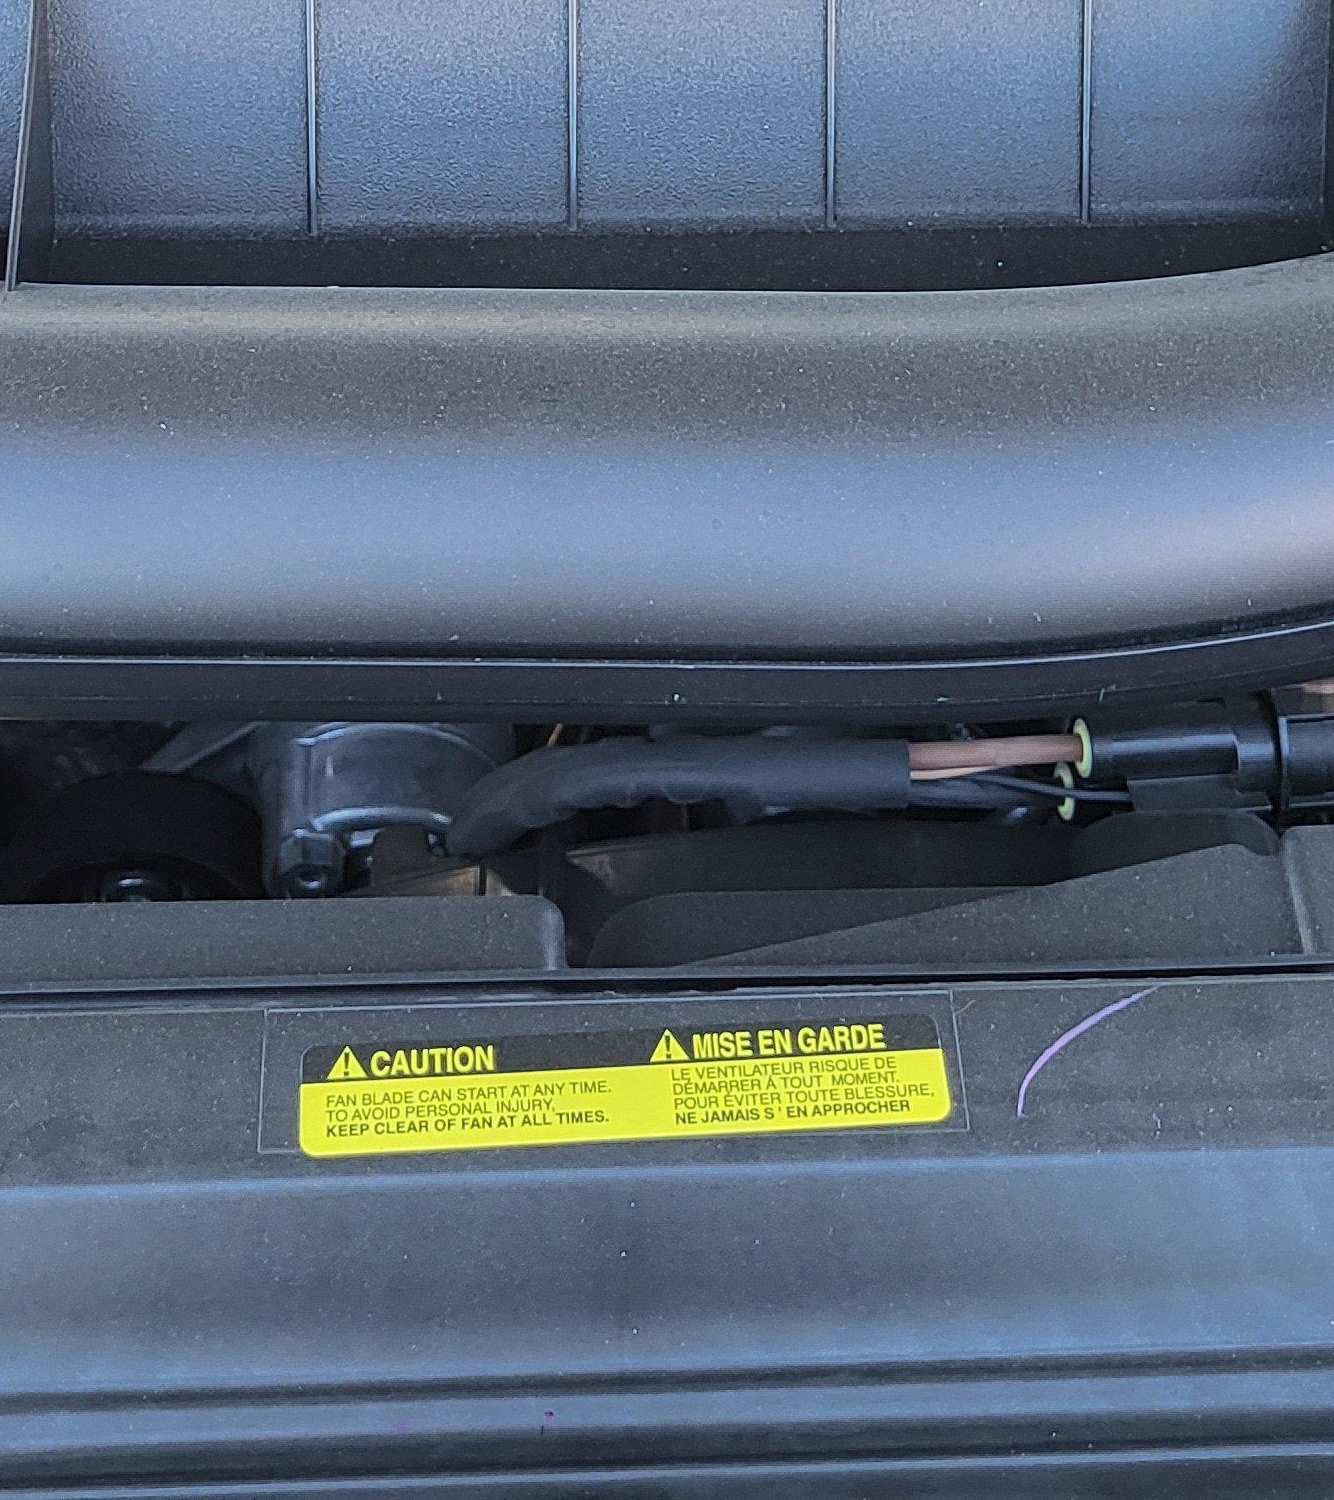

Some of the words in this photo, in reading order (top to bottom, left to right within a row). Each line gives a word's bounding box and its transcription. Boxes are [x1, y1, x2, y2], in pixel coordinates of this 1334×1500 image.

[692, 1032, 755, 1060] MISE
[758, 1029, 798, 1055] EN
[797, 1024, 887, 1052] GARDE
[370, 1045, 495, 1078] CAUTION
[671, 1068, 691, 1081] LE
[695, 1061, 805, 1080] VENTILATEUR
[809, 1058, 870, 1074] RISQUE
[874, 1056, 897, 1070] DE
[326, 1093, 357, 1108] FAN
[362, 1090, 414, 1106] BLADE
[417, 1088, 454, 1103] CAN
[457, 1085, 508, 1101] START
[510, 1083, 530, 1098] AT
[533, 1081, 566, 1097] ANY
[569, 1080, 612, 1094] TIME.
[672, 1077, 762, 1096] DÉMARRER
[780, 1075, 822, 1089] TOUT
[831, 1071, 900, 1086] MOMENT.
[674, 1094, 719, 1110] POUR
[724, 1089, 781, 1108] ÉVITER
[785, 1087, 840, 1103] TOUTE
[844, 1083, 936, 1101] BLESSURE,
[326, 1109, 348, 1123] TO
[351, 1106, 400, 1122] AVOID
[406, 1102, 492, 1120] PERSONAL
[497, 1099, 556, 1114] INJURY,
[326, 1122, 369, 1138] KEEP
[375, 1118, 429, 1135] CLEAR
[434, 1116, 456, 1132] OF
[461, 1115, 493, 1130] FAN
[497, 1113, 516, 1128] AT
[521, 1112, 552, 1127] ALL
[556, 1110, 610, 1125] TIMES.
[675, 1111, 697, 1125] NE
[701, 1107, 760, 1123] JAMAIS
[787, 1104, 808, 1119] EN
[812, 1100, 911, 1117] APPROCHER
